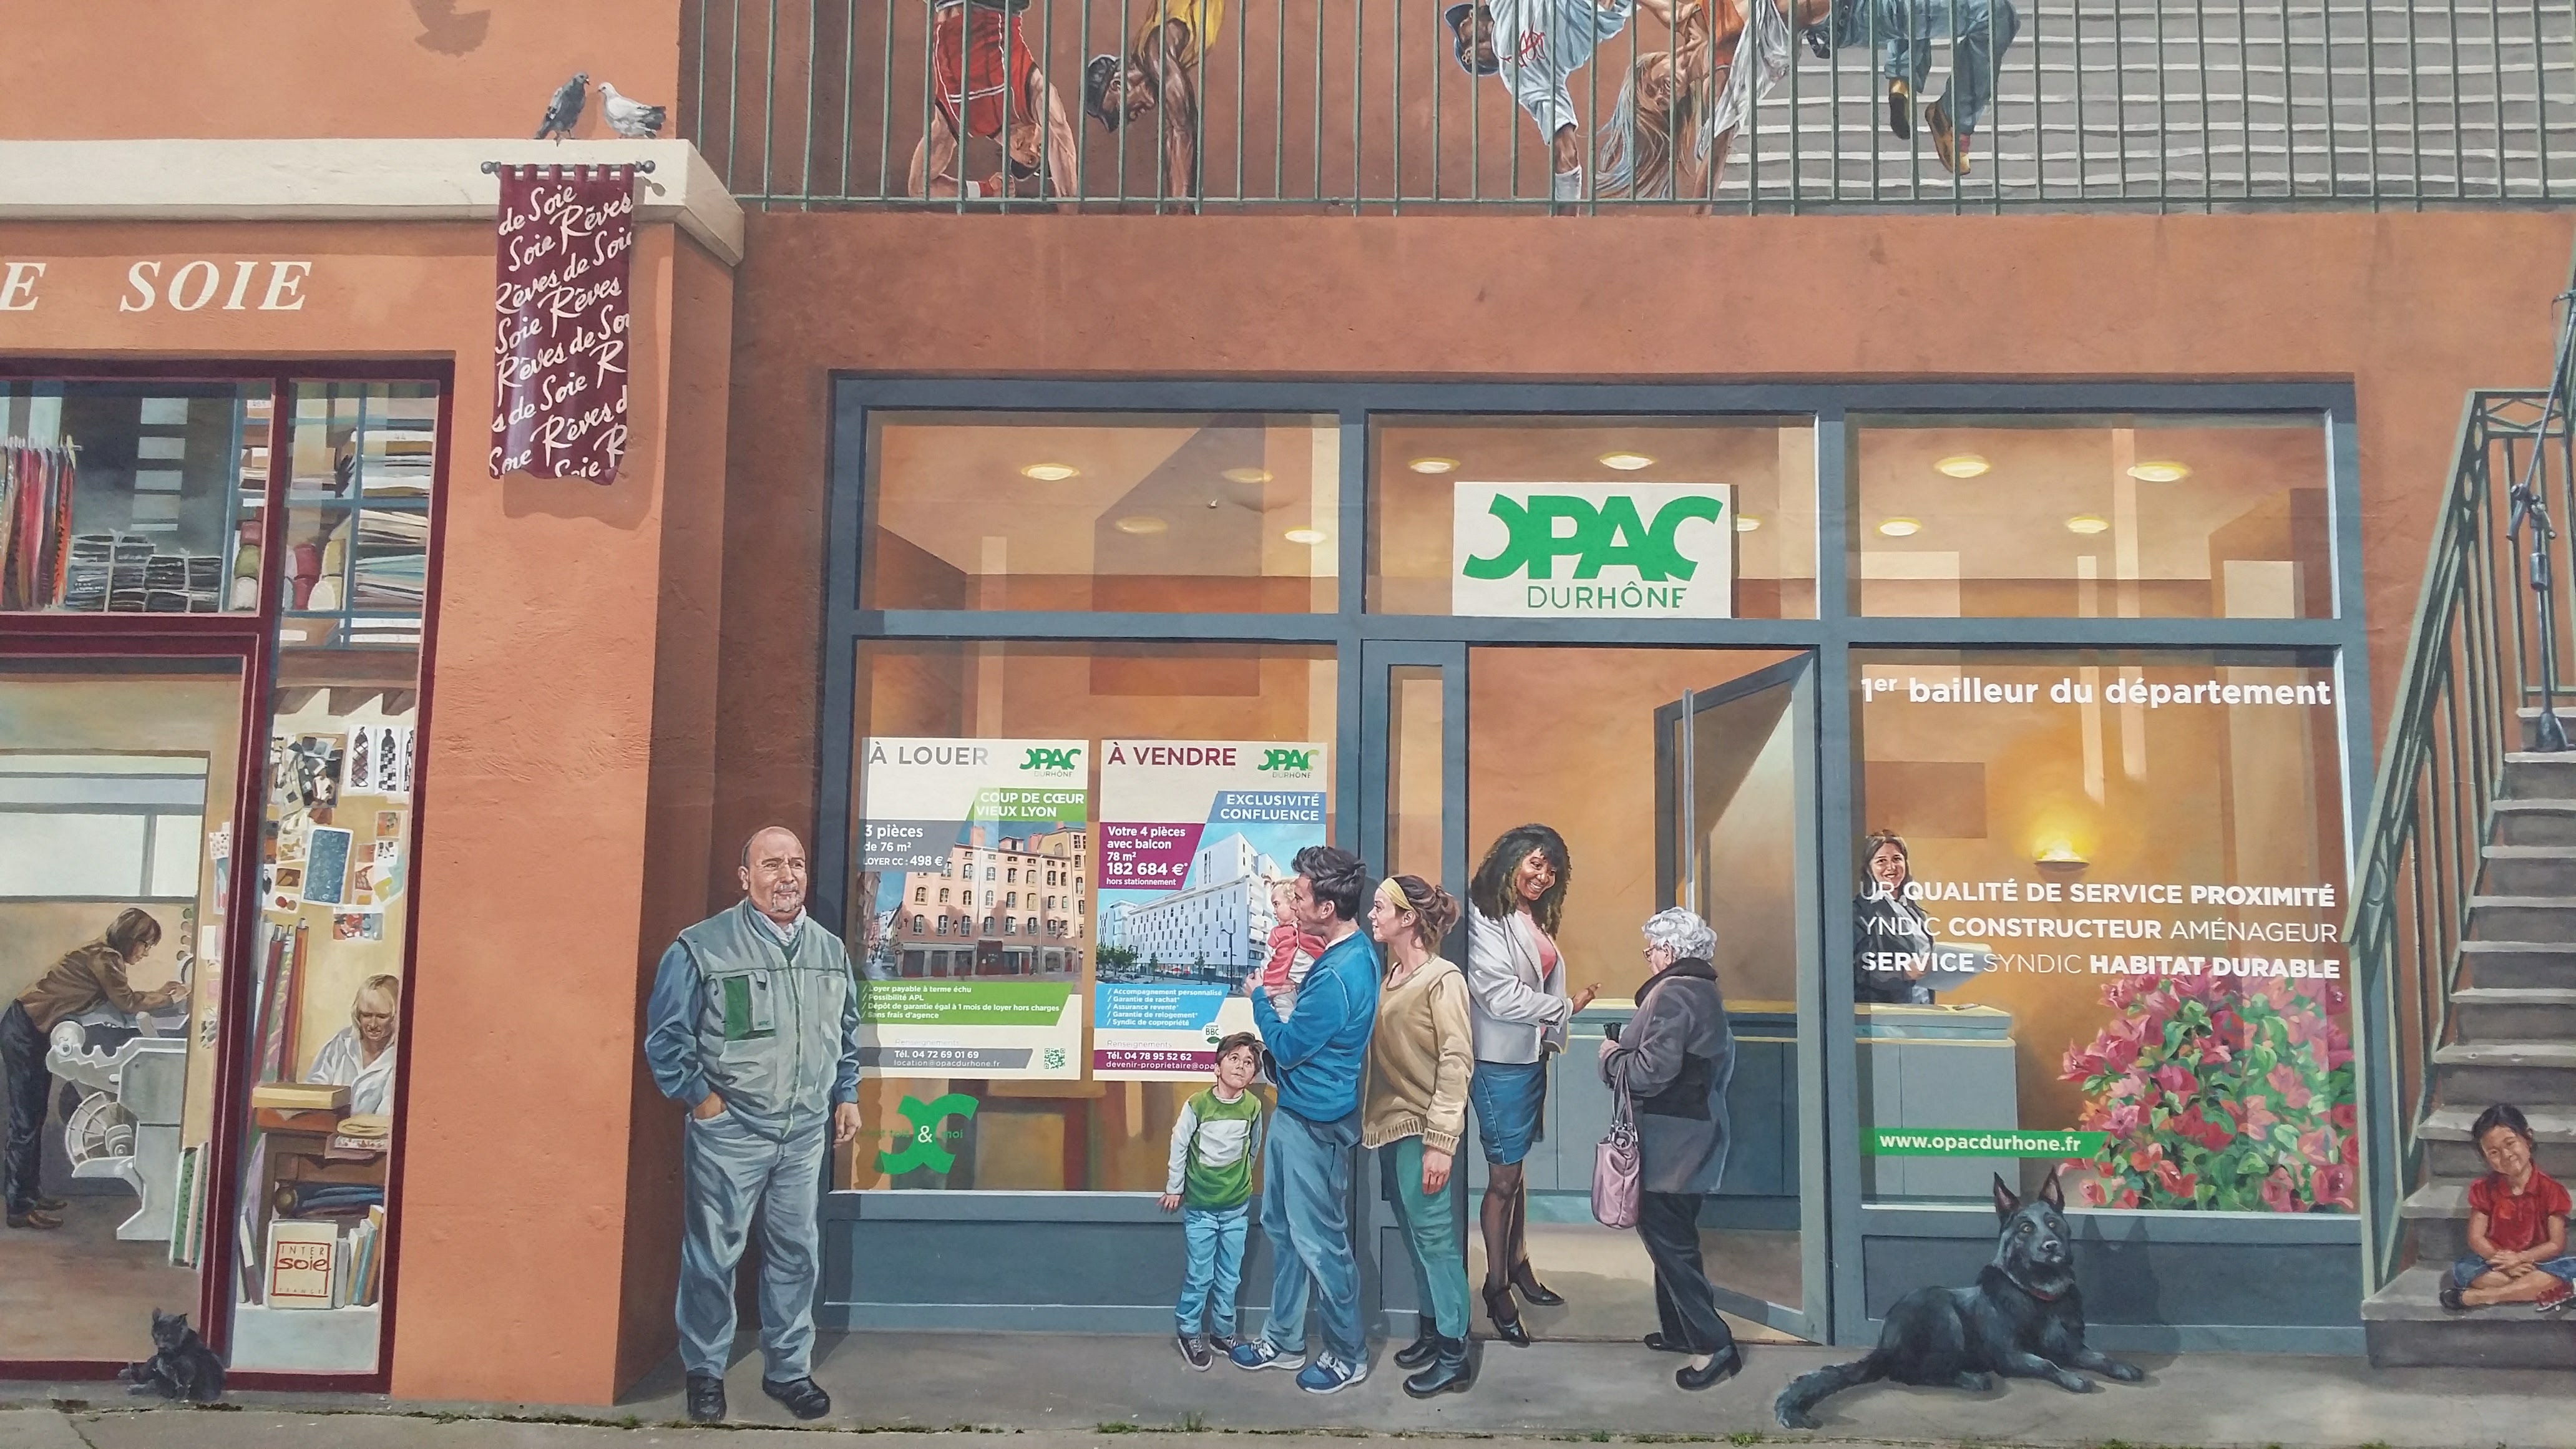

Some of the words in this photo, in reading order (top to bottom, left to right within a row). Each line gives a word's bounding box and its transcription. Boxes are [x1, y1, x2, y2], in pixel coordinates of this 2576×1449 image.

[499, 207, 525, 235] de
[529, 185, 577, 222] Soie
[509, 234, 555, 271] Soie
[549, 192, 633, 255] Rêves
[564, 253, 590, 281] de
[120, 260, 312, 312] SOIE
[495, 316, 542, 354] Soie
[537, 277, 622, 338] Rêves
[496, 343, 568, 407] Rêves
[570, 326, 595, 354] de
[508, 396, 537, 425] de
[540, 372, 588, 411] Soie
[589, 340, 627, 389] R
[530, 402, 615, 467] Rêves
[555, 457, 601, 477] Sie
[593, 422, 628, 468] R
[1528, 581, 1687, 608] DURHÔNE
[1861, 678, 1898, 702] 1er
[1909, 677, 2038, 703] bailleur
[2050, 678, 2092, 704] du
[2105, 678, 2331, 708] département
[869, 741, 887, 764] À
[899, 746, 988, 765] LOUER
[1108, 742, 1126, 765] À
[1133, 747, 1237, 766] VENDRE
[980, 793, 1018, 804] COUP
[1022, 793, 1040, 803] DE
[1043, 793, 1085, 804] CŒUR
[1227, 794, 1319, 807] EXCLUSIVITÉ
[976, 806, 1017, 817] VIEUX
[1021, 807, 1057, 817] LYON
[1221, 809, 1319, 821] CONFLUENCE
[865, 824, 872, 837] 3
[877, 824, 924, 839] pièces
[1108, 826, 1137, 836] Votre
[1140, 826, 1148, 836] 4
[1151, 826, 1186, 837] pièces
[864, 841, 877, 851] de
[881, 842, 894, 852] 76
[897, 842, 911, 852] m²
[1107, 841, 1132, 849] avec
[1135, 839, 1171, 849] balcon
[864, 857, 890, 866] LOYER
[910, 856, 932, 866] 498
[934, 856, 944, 866] €
[1107, 852, 1120, 861] 78
[1123, 852, 1136, 861] m²
[1107, 862, 1133, 875] 182
[1137, 863, 1168, 876] 684
[1860, 881, 1895, 900] UR
[1903, 879, 2018, 902] QUALITÉ
[2027, 883, 2062, 902] DE
[2070, 884, 2183, 904] SERVICE
[2191, 884, 2335, 907] PROXIMITÉ
[1860, 916, 1941, 936] YNDIC
[1948, 917, 2162, 939] CONSTRUCTEUR
[2170, 918, 2337, 943] AMÉNAGEUR
[1861, 952, 1974, 972] SERVICE
[1983, 954, 2082, 973] SYNDIC
[2090, 955, 2206, 975] HABITAT
[2213, 957, 2341, 978] DURABLE
[868, 1002, 890, 1010] Dépôt
[912, 1050, 925, 1058] 04
[967, 1051, 979, 1059] 69
[1106, 1051, 1121, 1060] Tél.
[894, 1060, 1000, 1068] location@opacdurhone.fr
[917, 1125, 933, 1143] &
[1880, 1134, 2081, 1152] www.opacdurhone.fr
[282, 1246, 324, 1256] INTER
[275, 1256, 331, 1272] soie
